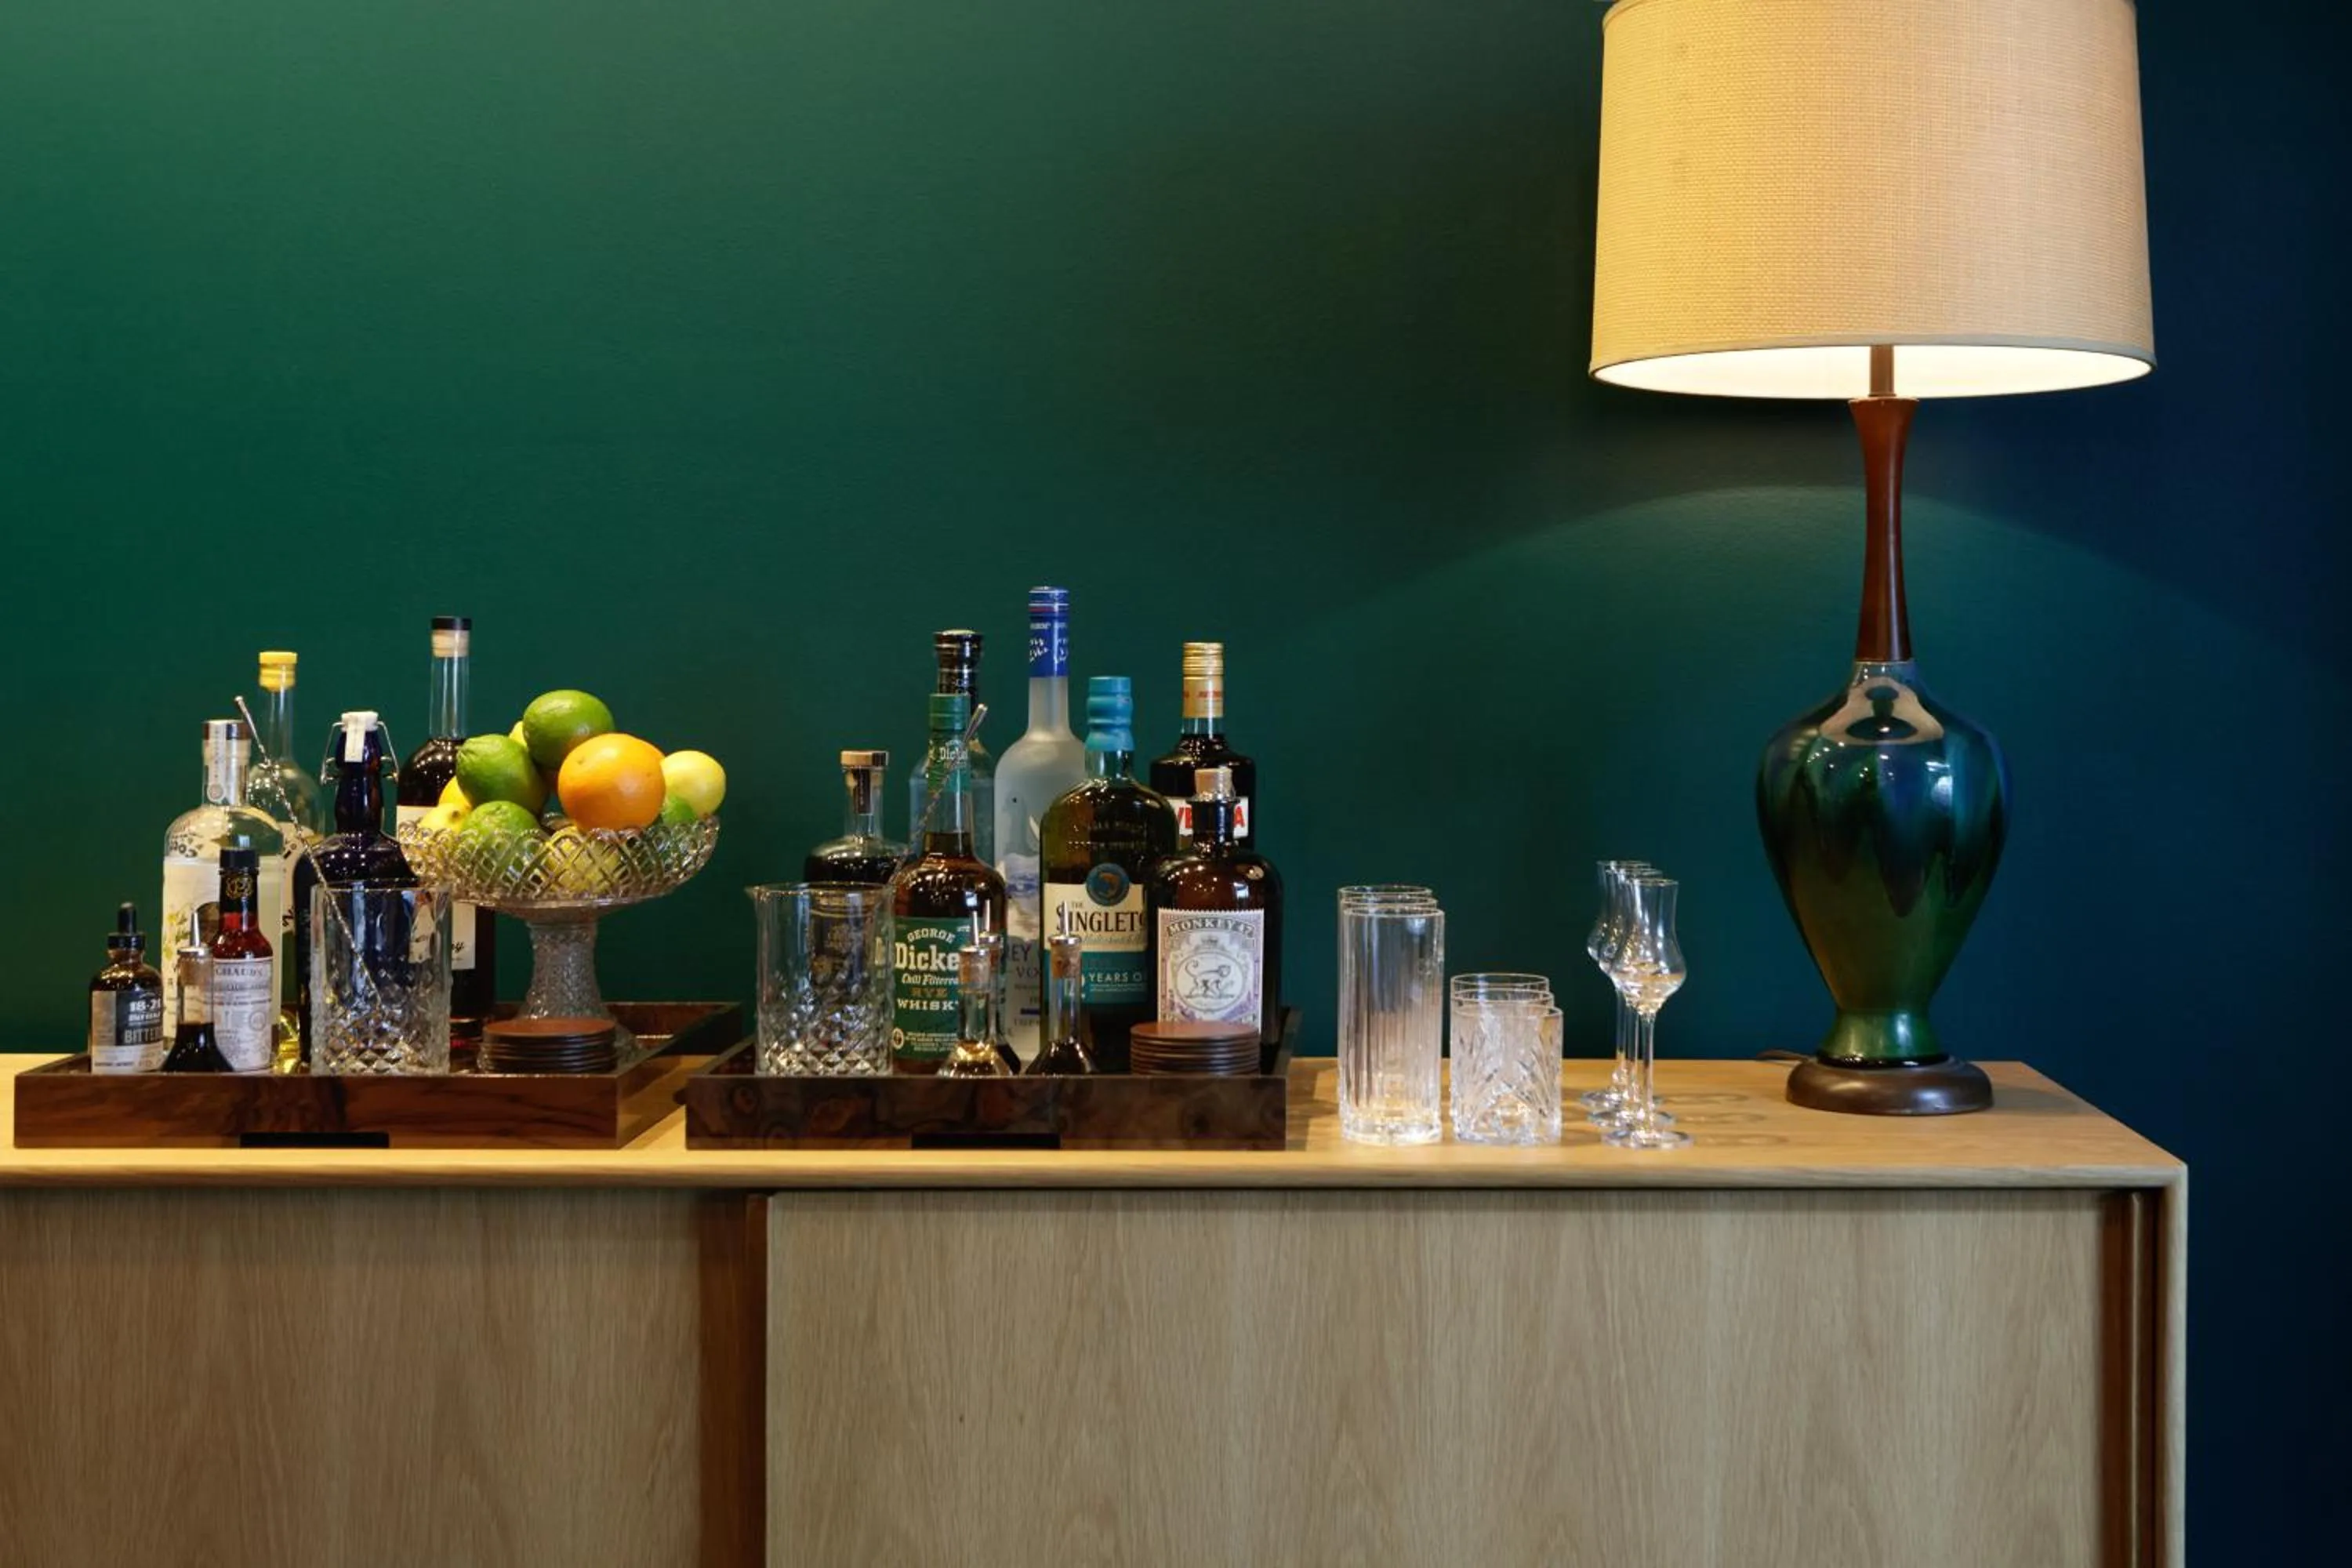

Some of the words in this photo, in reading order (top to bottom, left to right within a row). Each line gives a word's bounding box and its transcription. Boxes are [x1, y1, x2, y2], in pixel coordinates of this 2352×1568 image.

[1167, 917, 1233, 935] MONKEY
[907, 927, 956, 943] GEORGE
[895, 942, 960, 971] Dicke
[922, 973, 958, 986] Filtere
[1089, 972, 1128, 983] YEARS
[897, 999, 958, 1011] WHISK
